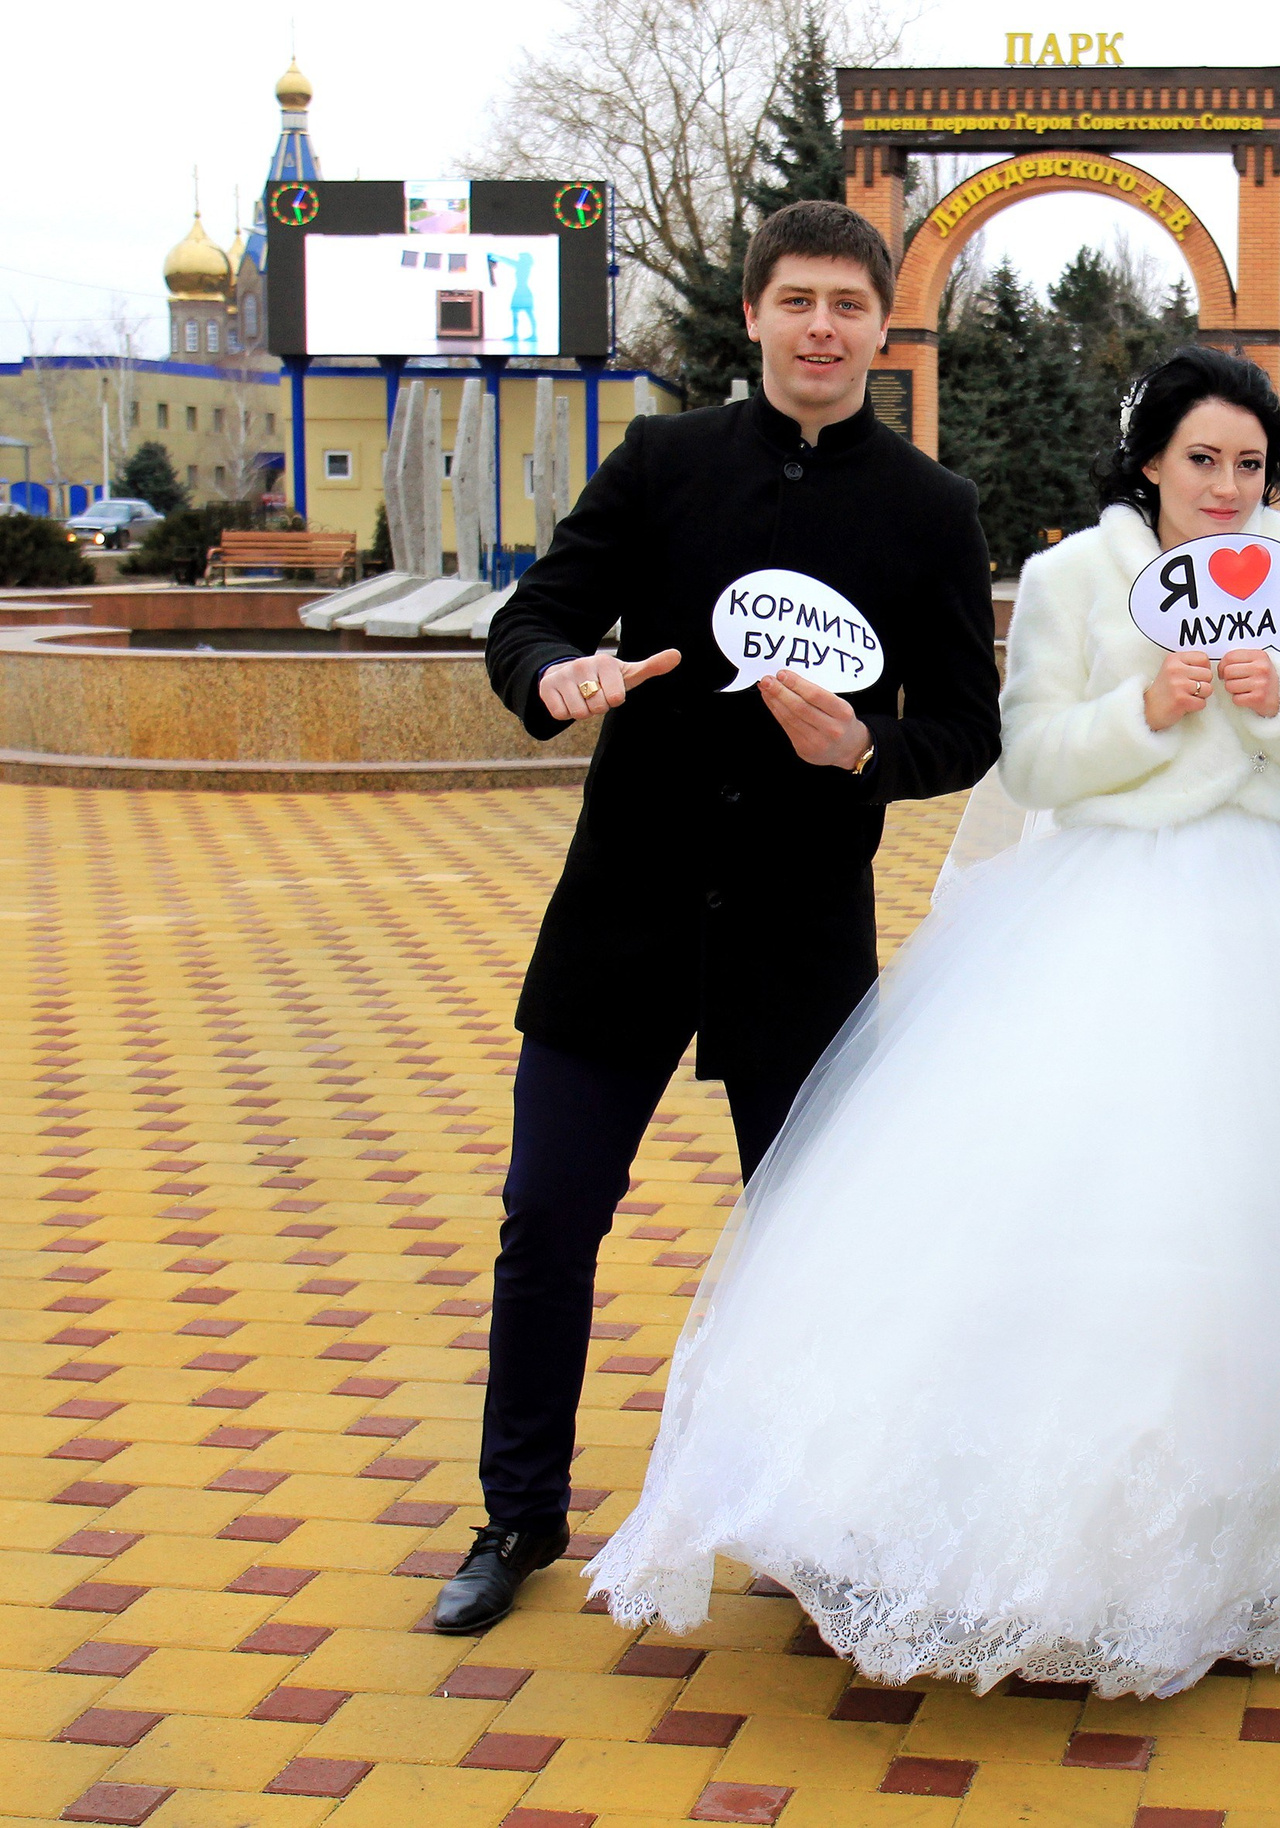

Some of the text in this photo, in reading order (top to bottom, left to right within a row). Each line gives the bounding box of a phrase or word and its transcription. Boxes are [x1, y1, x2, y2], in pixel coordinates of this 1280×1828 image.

[1004, 32, 1124, 65] ПАРК
[863, 112, 1264, 134] имени первого Героя Советского Союза
[931, 158, 1138, 238] Ляпидевского
[1159, 554, 1198, 612] Я
[730, 589, 876, 650] КОРМИТЬ
[1179, 608, 1277, 647] МУЖА
[743, 631, 864, 678] БУДУТ?
